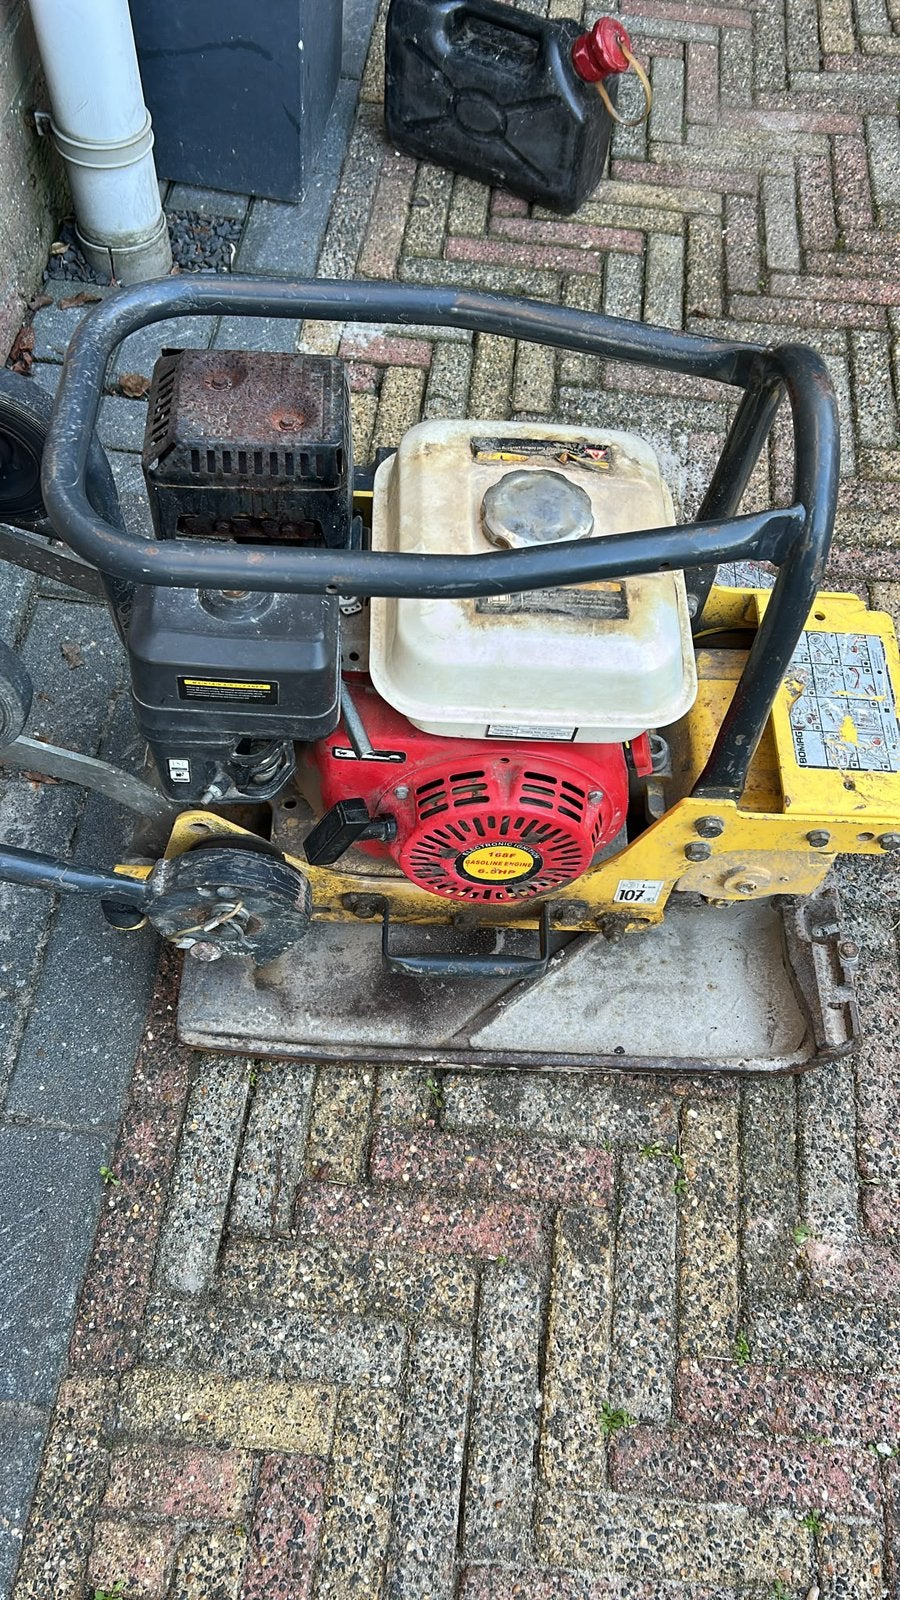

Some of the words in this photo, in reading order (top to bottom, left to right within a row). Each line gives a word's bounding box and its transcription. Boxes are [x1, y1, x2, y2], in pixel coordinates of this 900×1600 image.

[794, 731, 808, 764] BOMAG
[462, 841, 513, 856] ELECTRONIC
[513, 842, 541, 859] IGNITION
[488, 851, 517, 859] 168F
[465, 859, 502, 867] GASOLINE
[619, 889, 646, 902] 107
